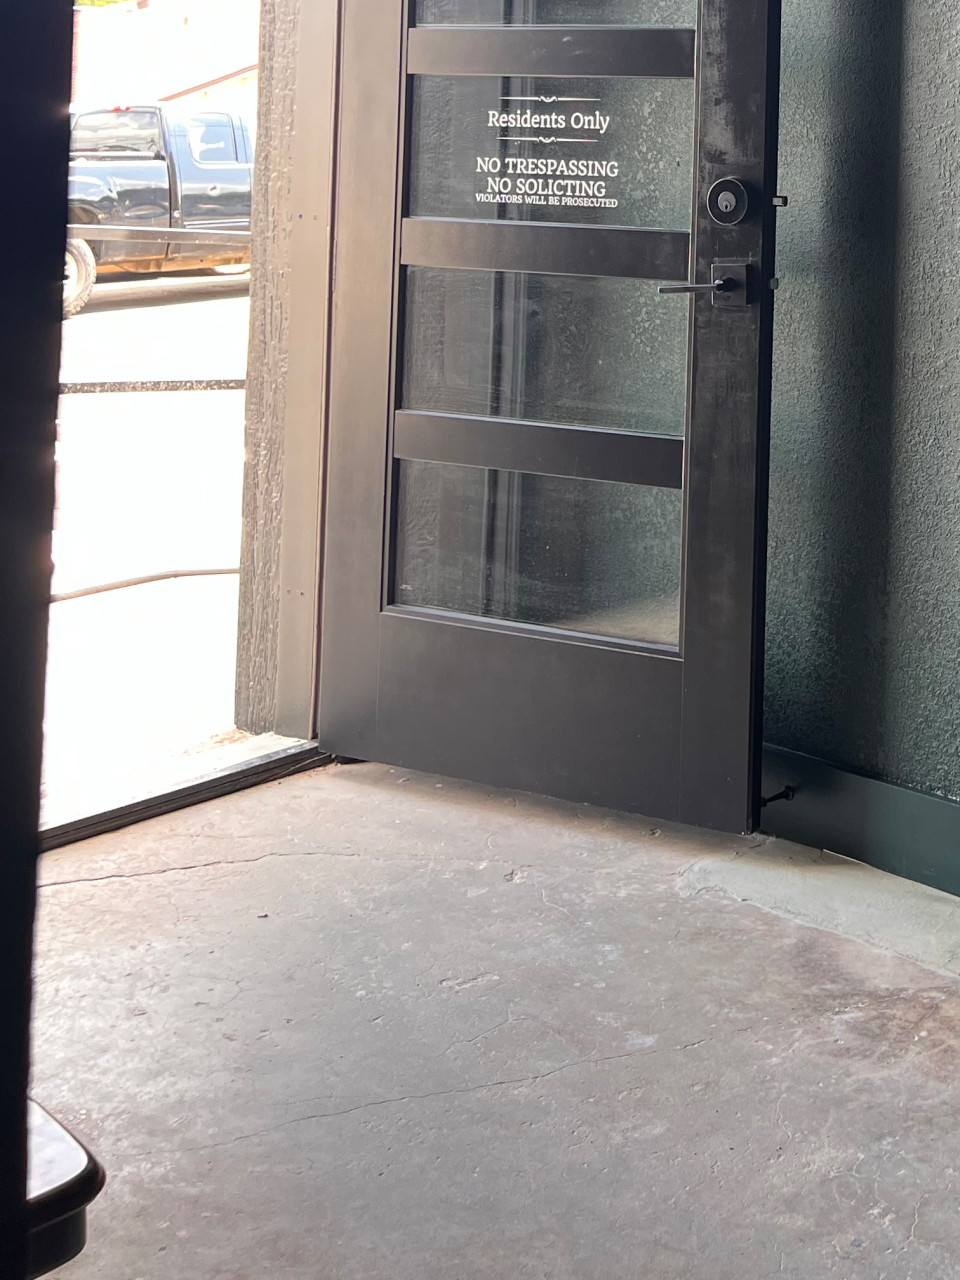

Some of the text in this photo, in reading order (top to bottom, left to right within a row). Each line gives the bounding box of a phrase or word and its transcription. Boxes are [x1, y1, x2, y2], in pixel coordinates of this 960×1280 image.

[487, 109, 610, 134] Residents Only
[476, 156, 619, 177] NO TRESPASSING
[486, 177, 606, 198] NO SOLICTING
[475, 193, 619, 208] VIOLATORS WILL BE PROSECUTED
